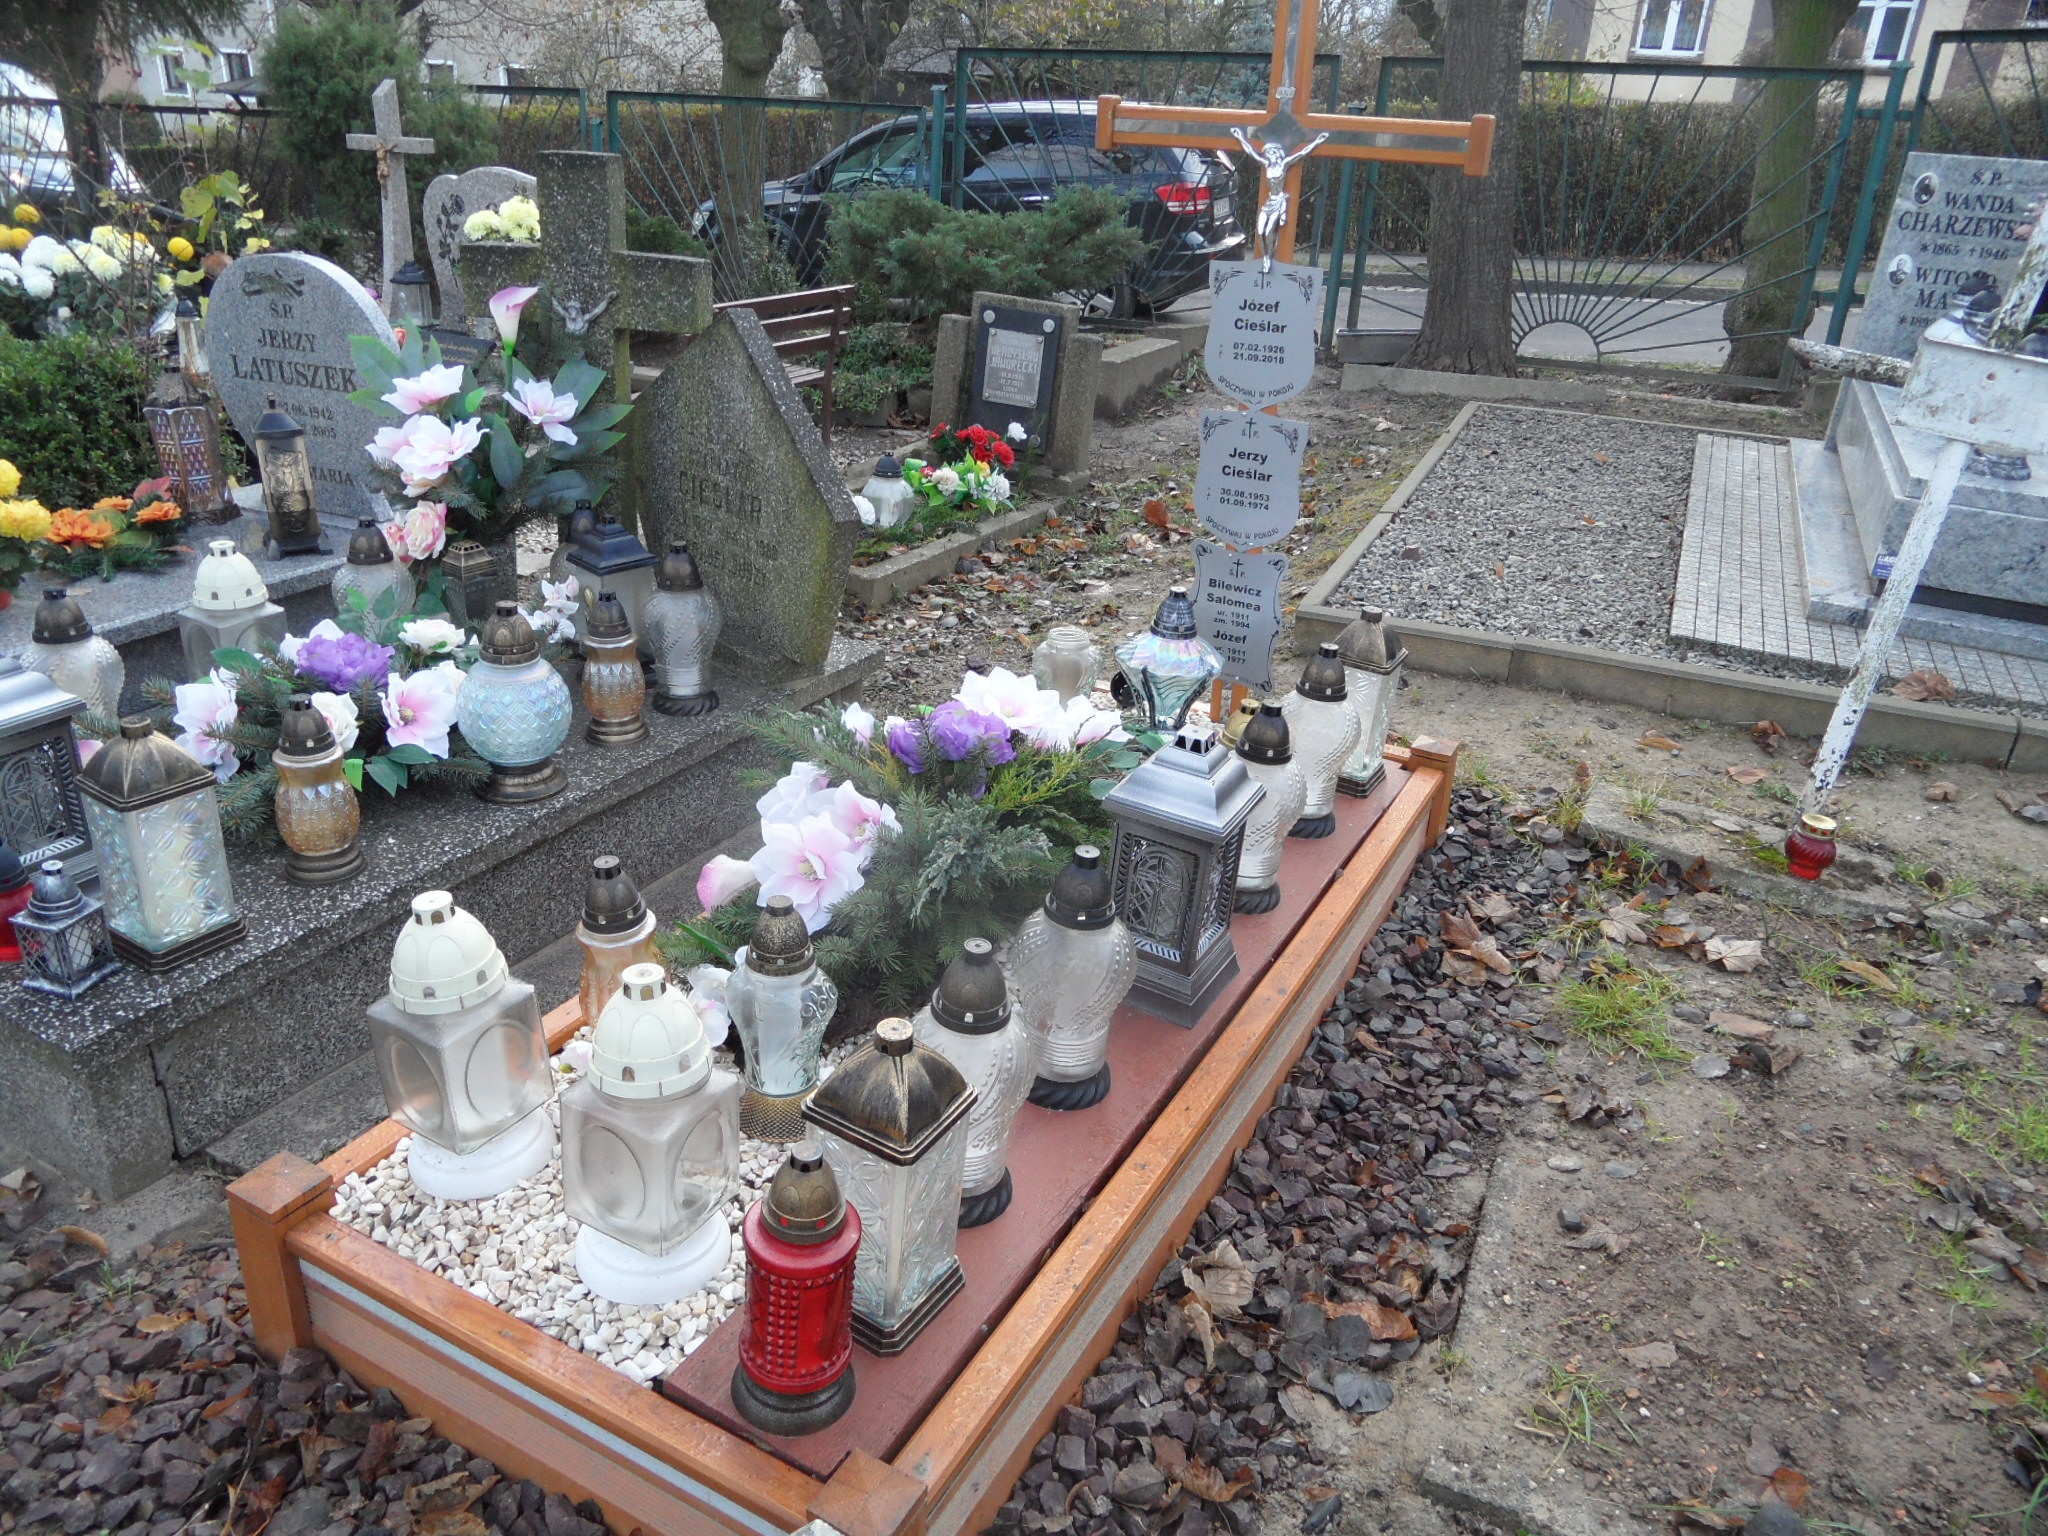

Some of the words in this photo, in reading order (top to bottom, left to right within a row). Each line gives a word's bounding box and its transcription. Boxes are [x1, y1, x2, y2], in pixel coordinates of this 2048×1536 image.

[1945, 191, 2015, 214] WANDA
[1266, 280, 1273, 289] P.
[1238, 298, 1280, 313] Józef
[1234, 317, 1287, 334] Cieślar
[258, 327, 317, 353] JERZY
[1233, 342, 1285, 354] 07.02.1926
[1233, 352, 1285, 365] 21.09.2018
[229, 353, 359, 393] LATUSZEK
[1217, 375, 1256, 398] SPOCZYWAJ
[1258, 390, 1265, 398] W
[1268, 382, 1294, 398] POKOJU
[1253, 429, 1260, 438] P.
[1228, 447, 1268, 465] Jerzy
[1221, 465, 1273, 483] Cieślar
[1220, 488, 1270, 502] 30.08.1953
[1219, 496, 1269, 511] 01.09.1974
[1205, 515, 1242, 539] SPOCZYWAJ
[1253, 527, 1279, 540] POKOJU
[1208, 578, 1262, 597] Bilewicz
[1206, 593, 1261, 612] Salomea
[1213, 617, 1228, 625] zm.
[1230, 619, 1250, 629] 1994
[1217, 610, 1228, 618] ur.
[1231, 611, 1250, 621] 1911
[1212, 629, 1247, 645] Józef
[1227, 647, 1246, 657] 1911
[1227, 655, 1246, 665] 1977
